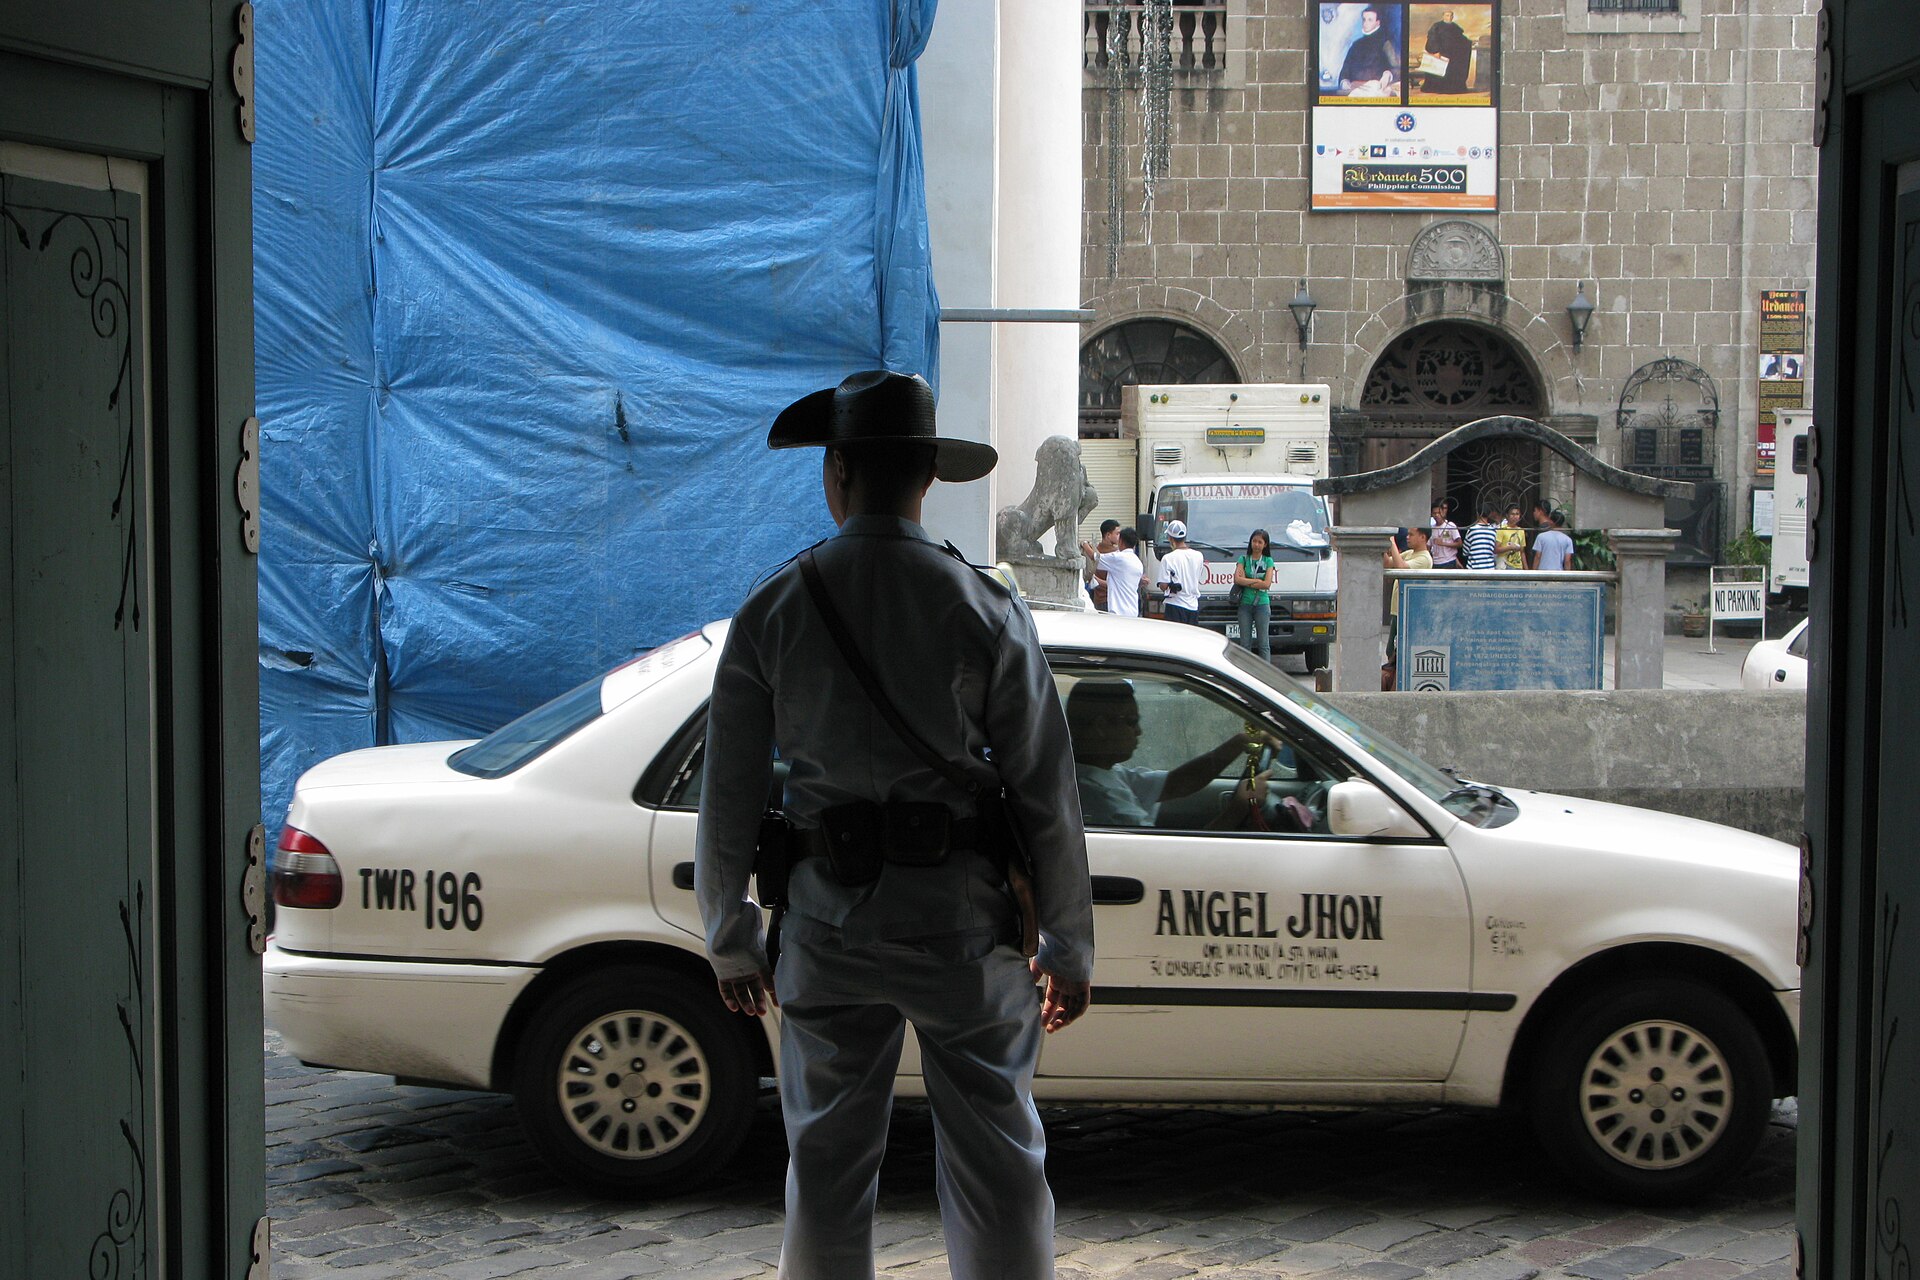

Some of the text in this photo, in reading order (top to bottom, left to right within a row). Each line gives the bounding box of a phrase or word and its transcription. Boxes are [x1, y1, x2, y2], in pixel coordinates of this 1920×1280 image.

[1345, 164, 1465, 188] Urdaneta 500
[1368, 183, 1409, 191] Philippine
[1768, 290, 1800, 299] Year of
[1761, 299, 1805, 313] Urdaneta
[1183, 485, 1235, 498] JULIAN
[1715, 589, 1761, 612] NO PARKING
[1416, 658, 1444, 673] UNESCO
[359, 868, 483, 932] TWR 196
[1155, 889, 1384, 941] ANGEL JHON
